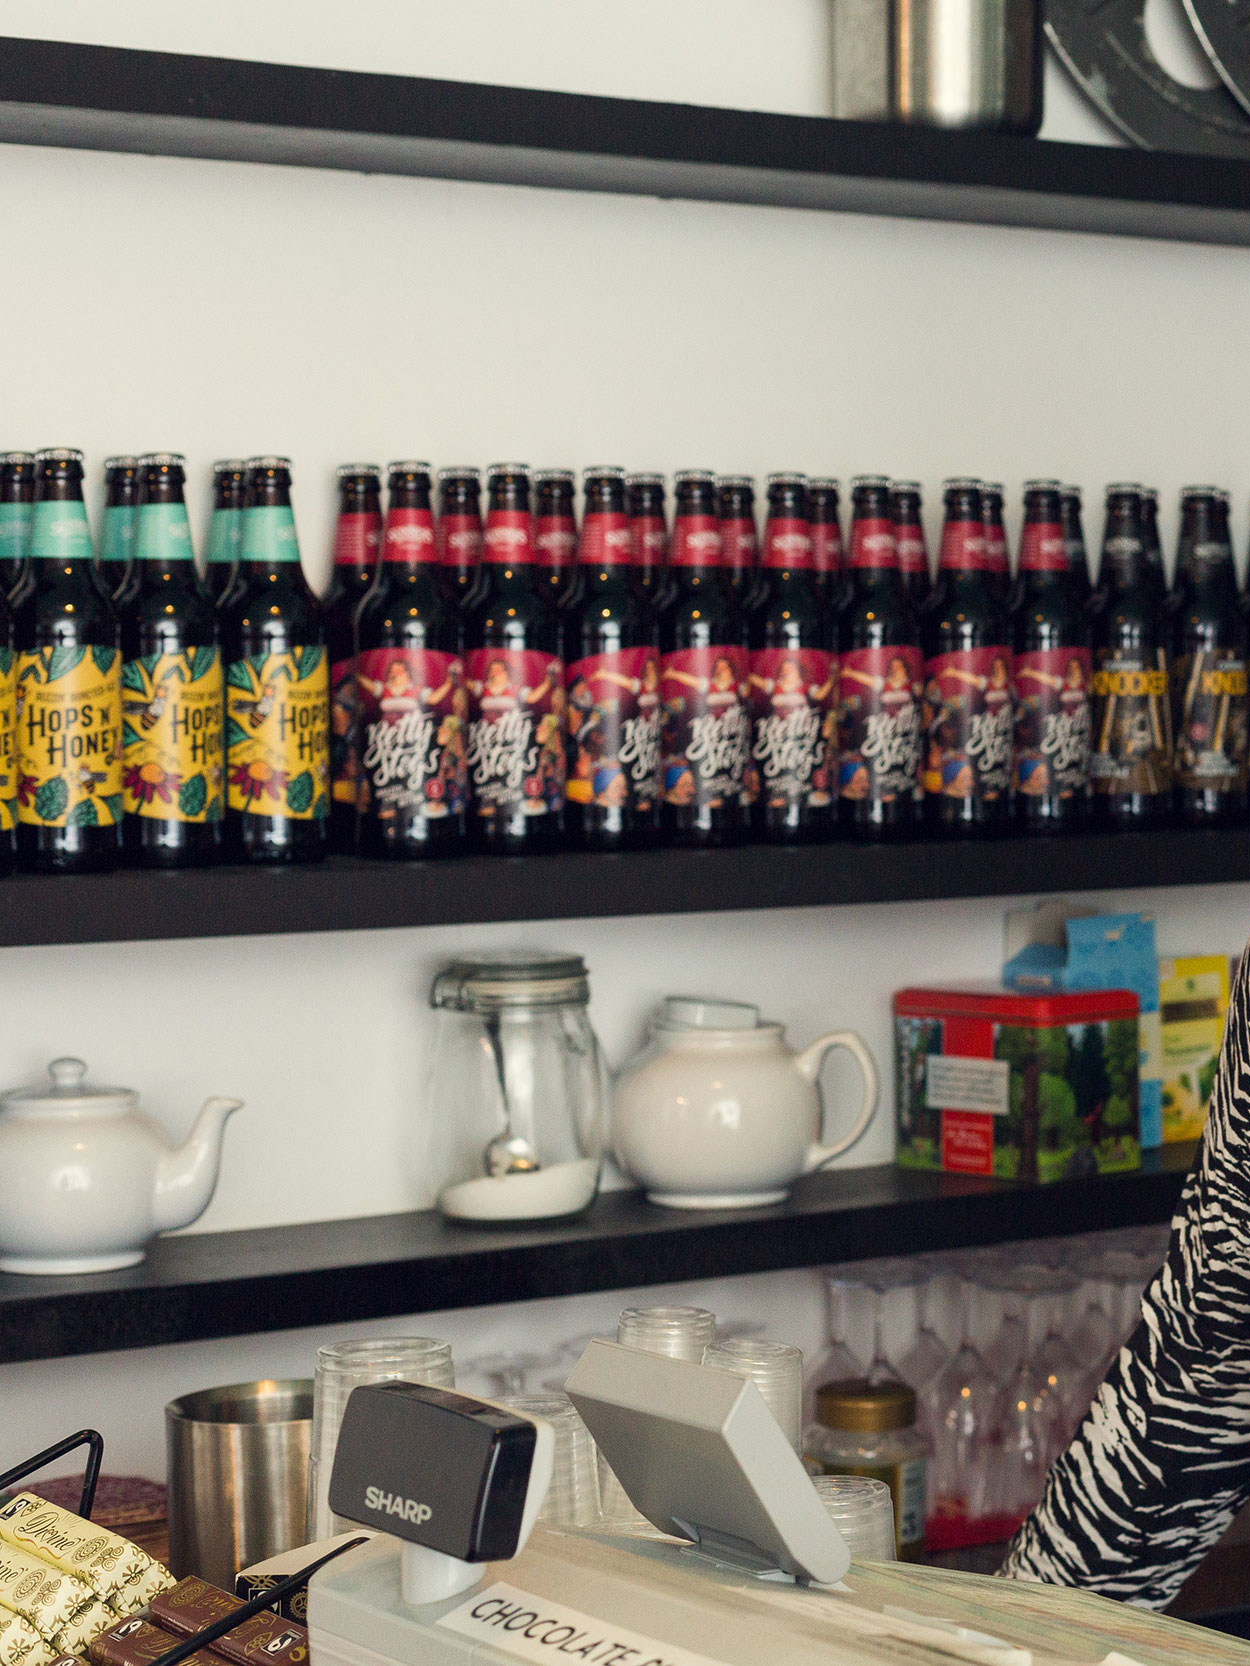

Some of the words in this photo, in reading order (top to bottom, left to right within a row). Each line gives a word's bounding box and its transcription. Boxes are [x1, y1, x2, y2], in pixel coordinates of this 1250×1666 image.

[26, 704, 94, 746] HOPS
[364, 1486, 433, 1525] SHARP
[18, 1511, 84, 1552] Divine
[470, 1598, 641, 1666] CHOCOLATE
